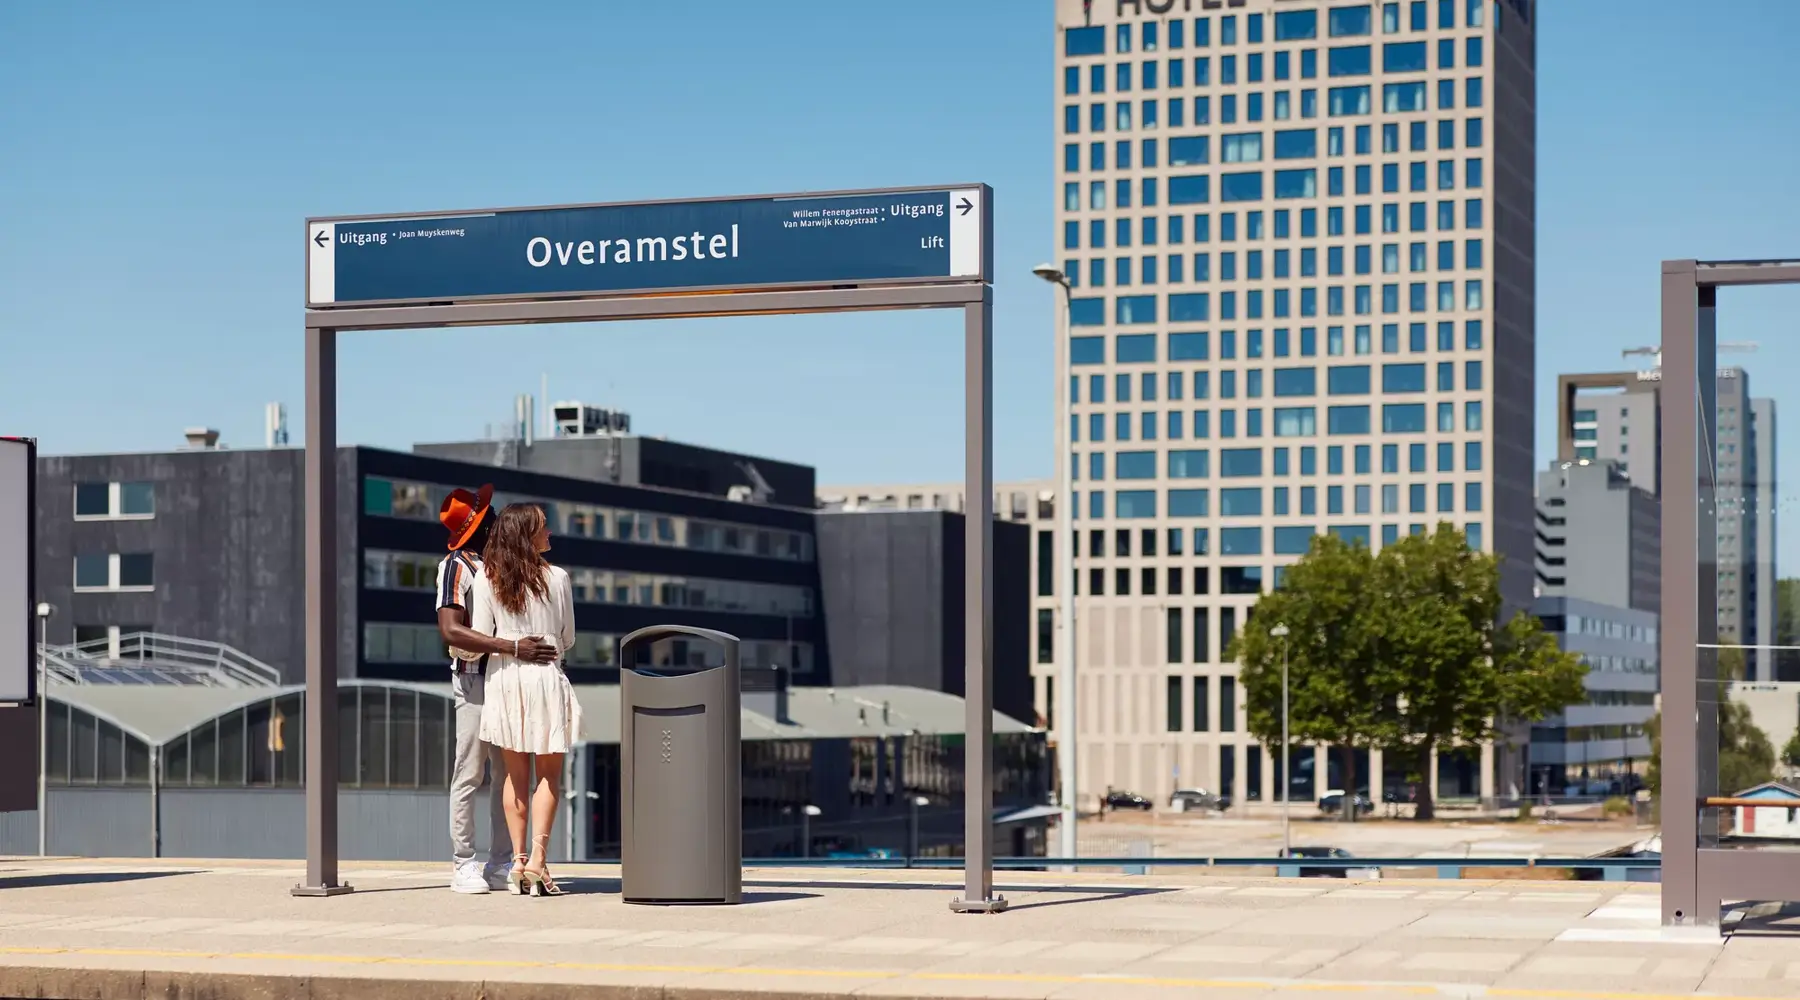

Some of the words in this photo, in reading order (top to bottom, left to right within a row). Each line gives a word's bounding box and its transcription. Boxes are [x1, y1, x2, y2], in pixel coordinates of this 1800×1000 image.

[792, 209, 821, 219] Willem
[822, 206, 879, 217] Fenengastraat
[890, 203, 944, 219] Uitgang
[783, 220, 798, 228] Van
[799, 218, 833, 228] Marwijk
[834, 216, 878, 227] Kooystraat
[339, 231, 388, 247] Uitgang
[398, 230, 416, 239] Joan
[417, 227, 465, 239] Muyskenweg
[526, 223, 740, 269] Overamstel
[921, 235, 945, 249] Lift
